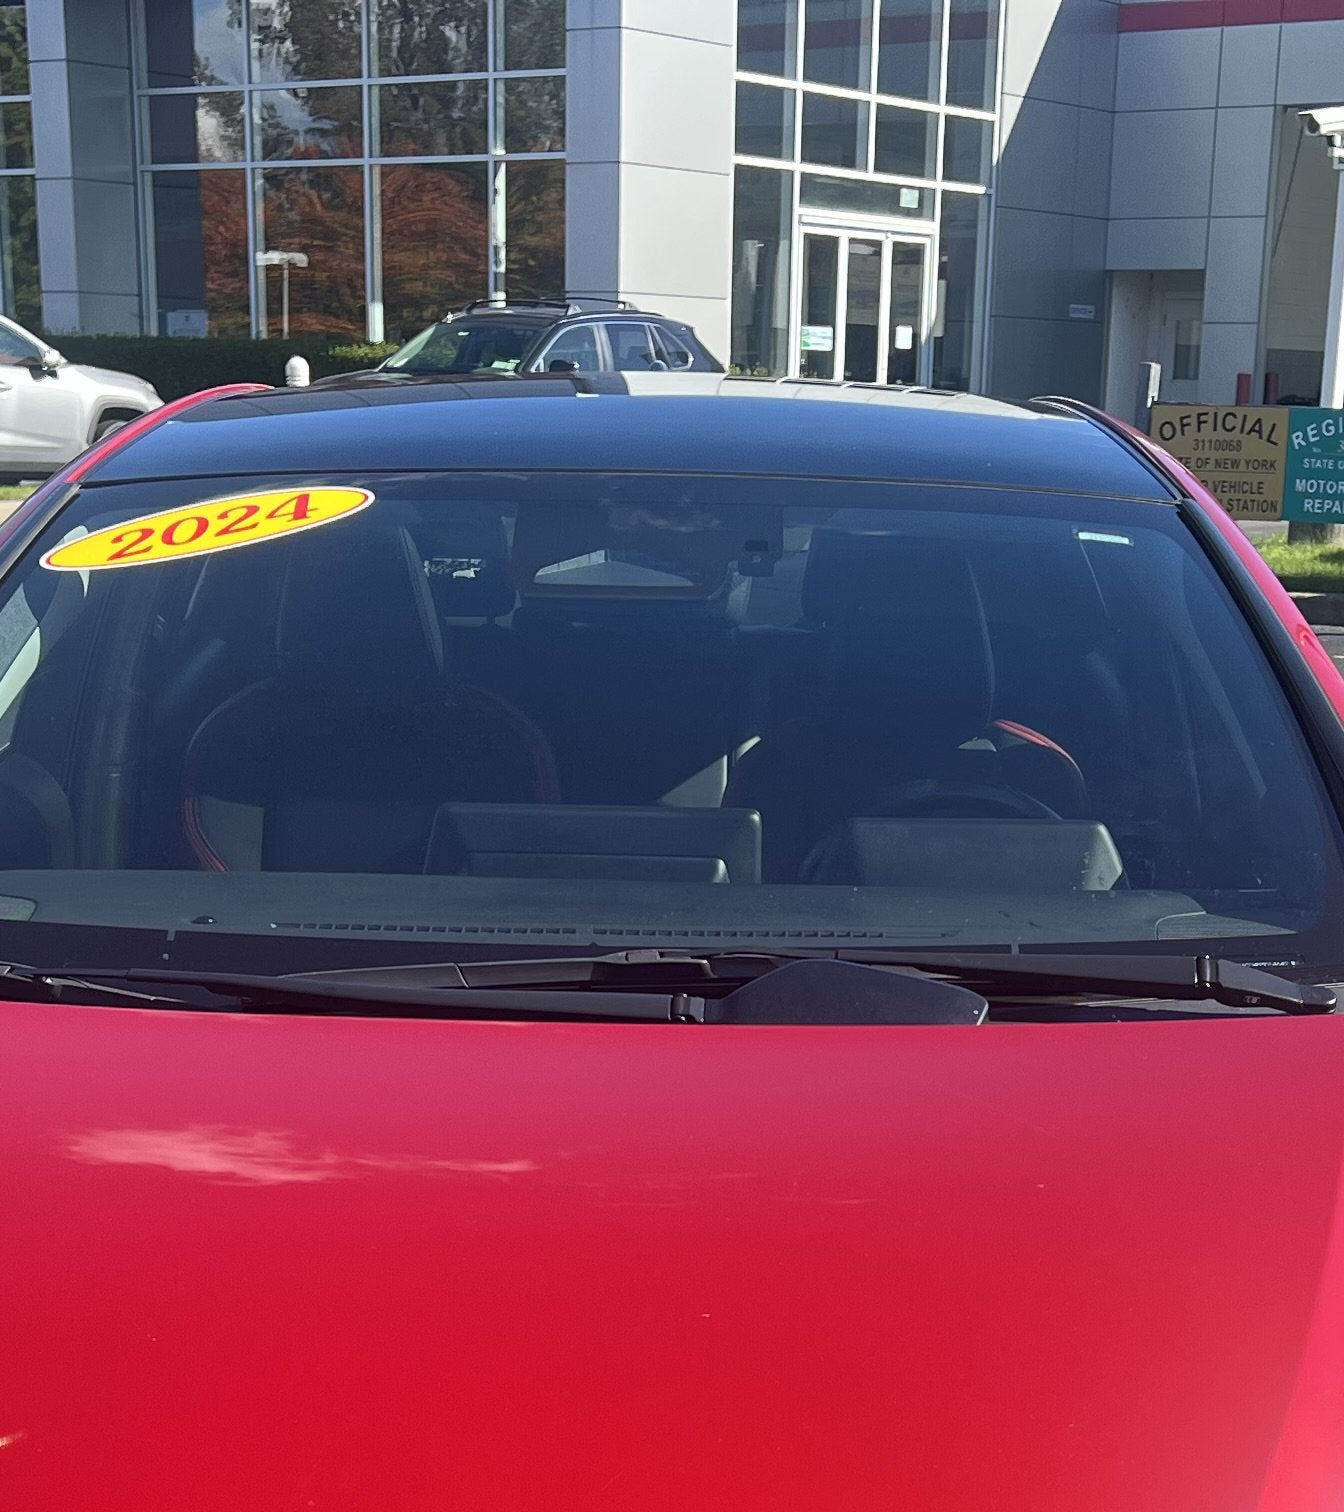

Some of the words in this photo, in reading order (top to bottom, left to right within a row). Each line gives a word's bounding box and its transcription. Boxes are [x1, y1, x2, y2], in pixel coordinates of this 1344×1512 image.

[1159, 411, 1279, 446] OFFICIAL
[1192, 439, 1242, 452] 3110068
[1196, 458, 1211, 469] OF
[1214, 458, 1241, 470] NEW
[1244, 460, 1277, 471] YORK
[1303, 458, 1334, 470] STATE
[1212, 480, 1264, 495] VEHICLE
[1226, 498, 1279, 513] STATION
[106, 493, 319, 562] 2024
